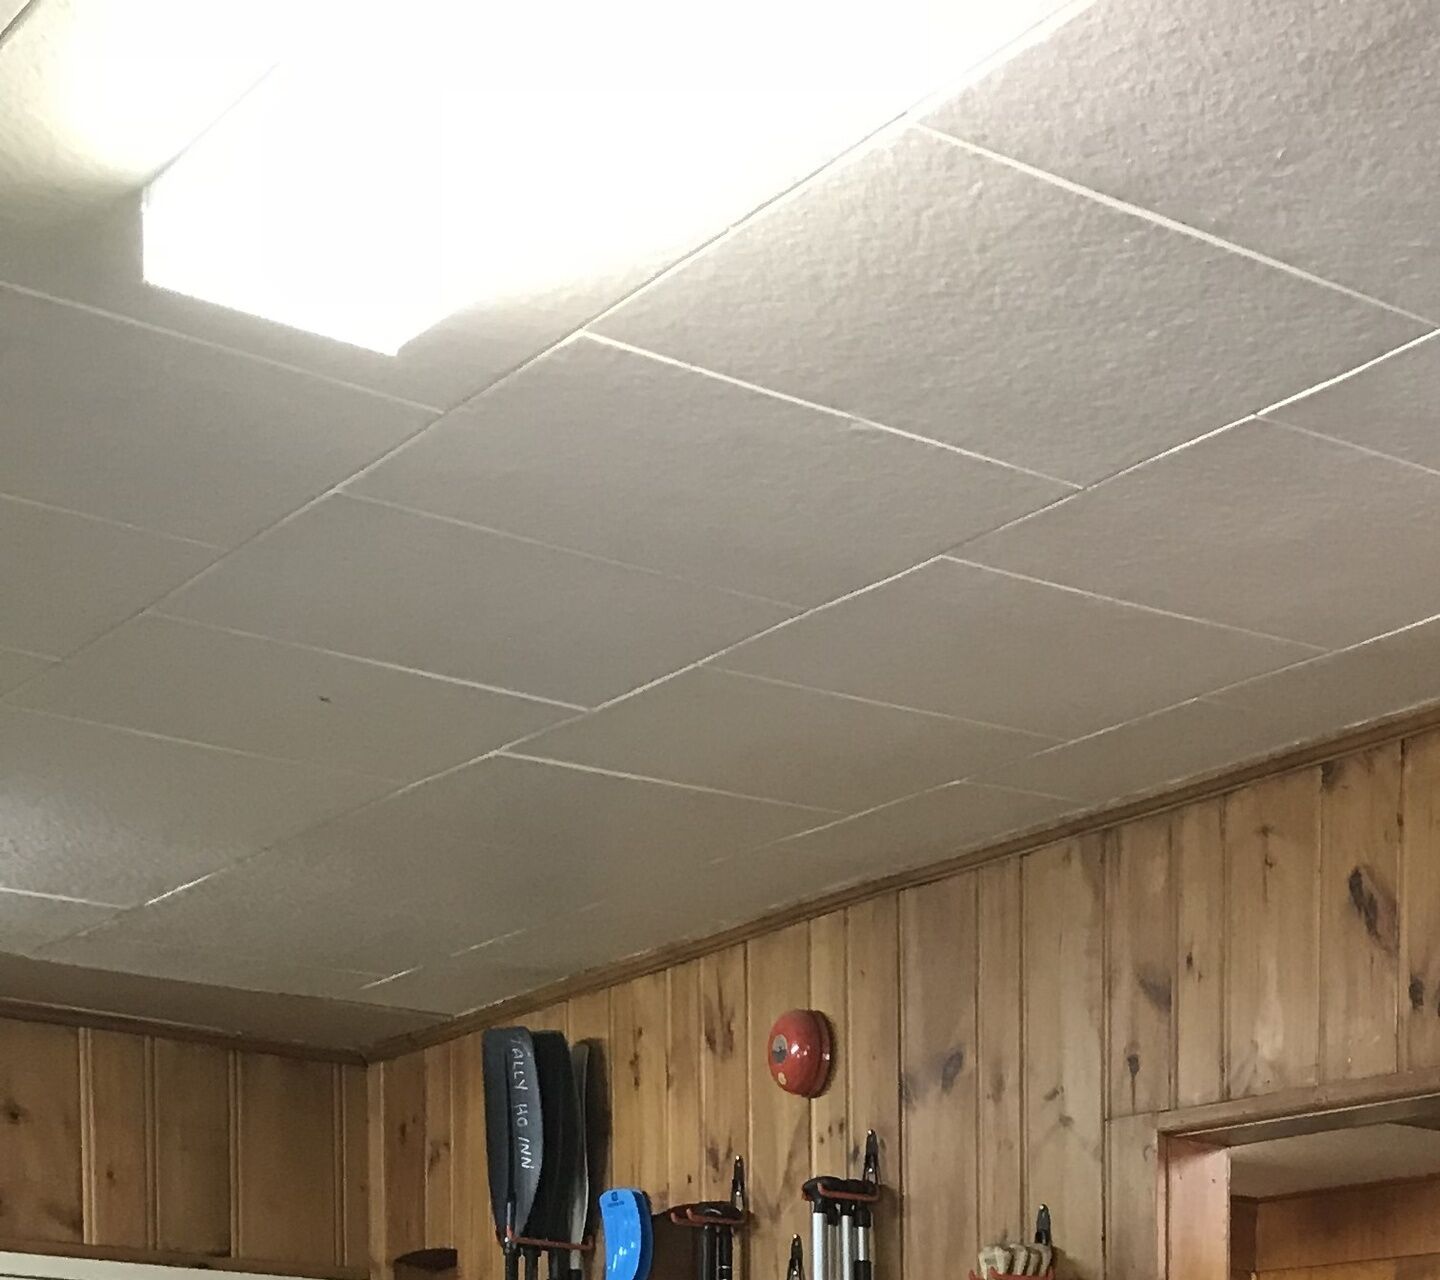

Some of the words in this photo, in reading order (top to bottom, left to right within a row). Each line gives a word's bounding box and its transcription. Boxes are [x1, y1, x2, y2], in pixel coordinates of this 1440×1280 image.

[510, 1035, 528, 1090] TALLY
[513, 1103, 528, 1127] HO
[517, 1136, 535, 1169] INN
